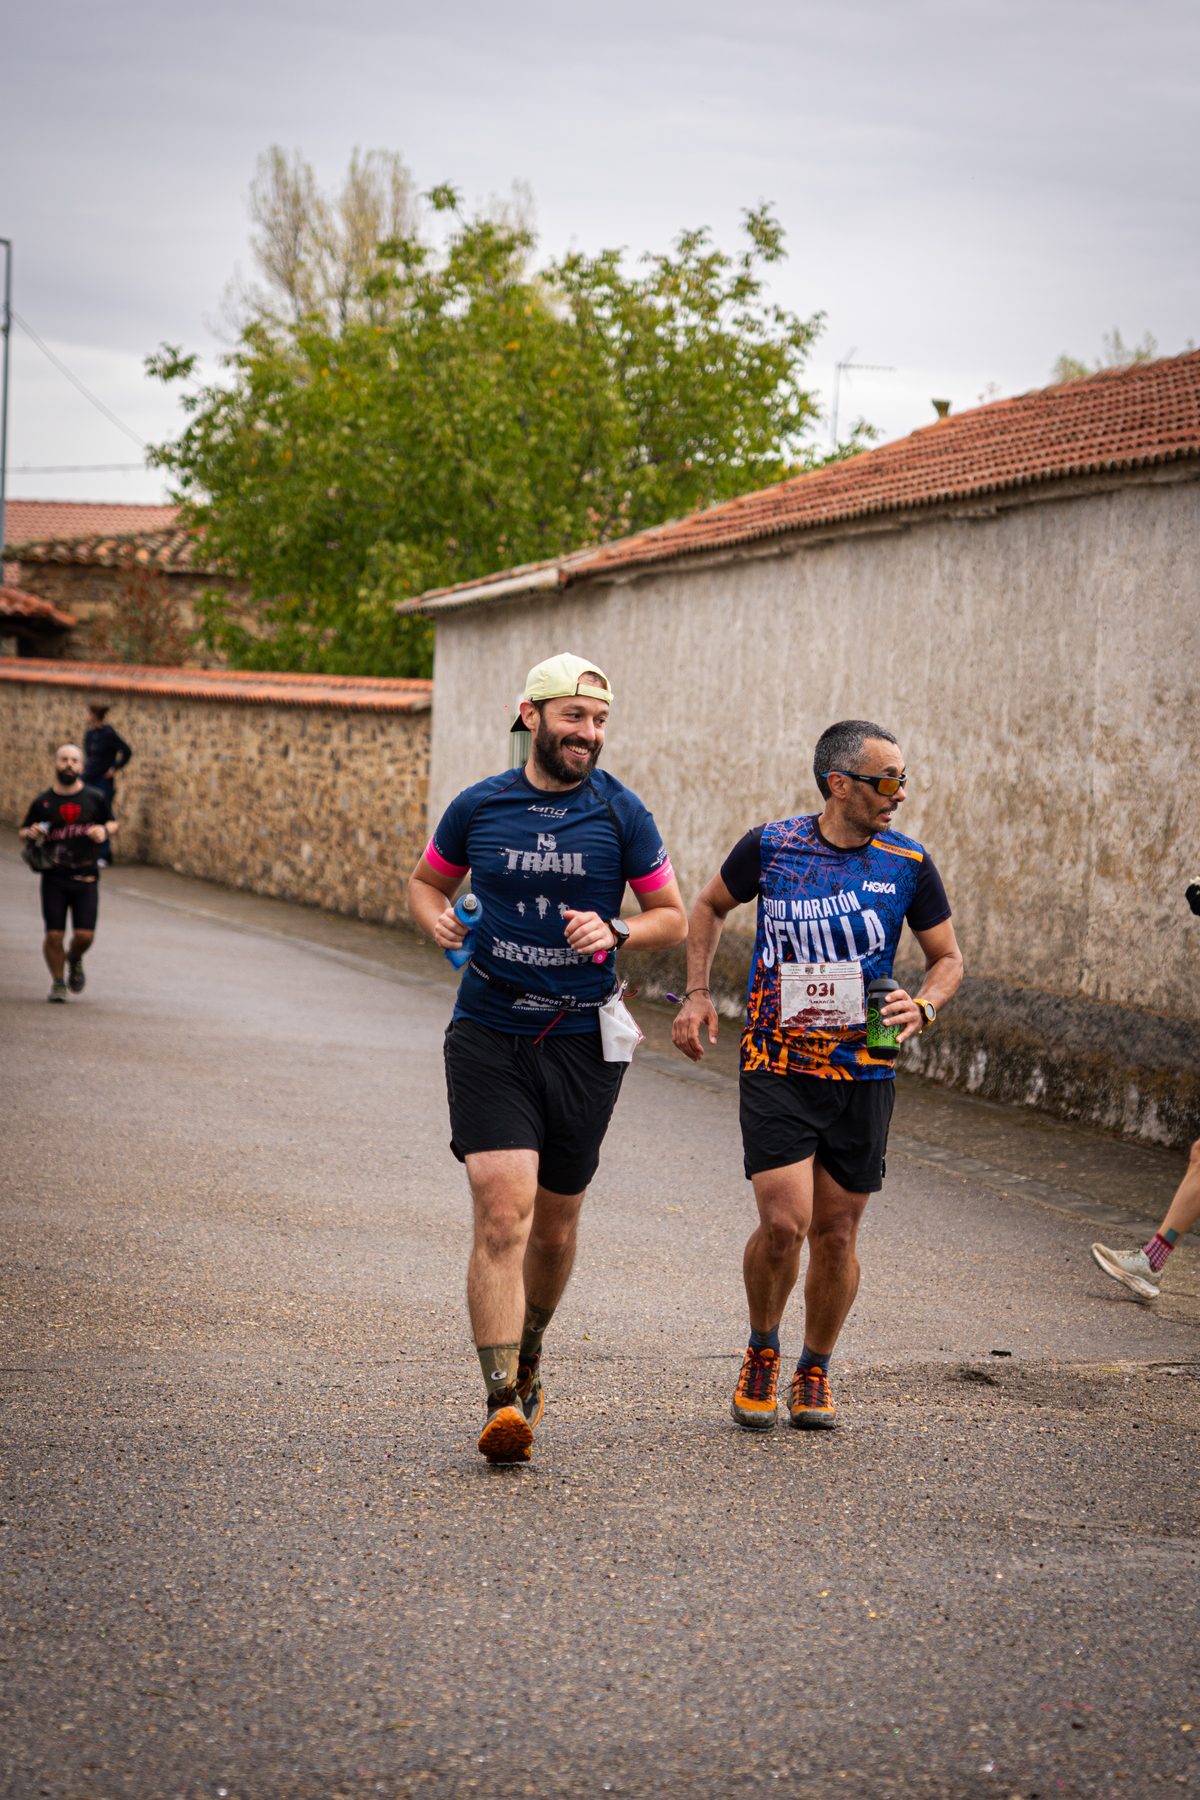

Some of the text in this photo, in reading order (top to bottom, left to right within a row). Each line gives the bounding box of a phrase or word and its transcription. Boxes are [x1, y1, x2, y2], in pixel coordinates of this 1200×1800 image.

[504, 849, 586, 876] TRAIL
[862, 880, 896, 895] HOKA
[791, 889, 861, 920] MARATÓN
[762, 909, 886, 969] SEVILLA
[806, 982, 835, 997] 031
